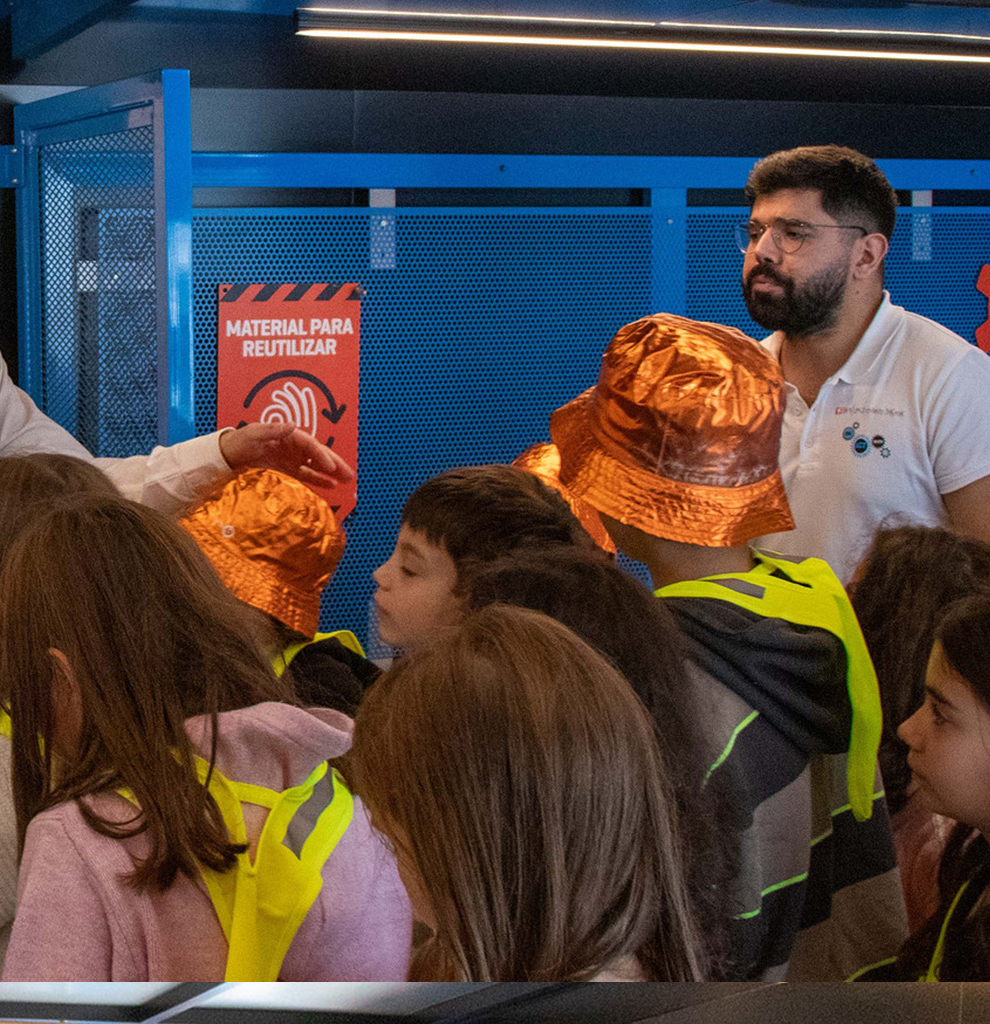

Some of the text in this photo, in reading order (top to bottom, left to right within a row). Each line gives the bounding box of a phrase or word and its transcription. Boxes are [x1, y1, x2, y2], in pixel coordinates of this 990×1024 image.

[226, 317, 354, 337] MATERIAL PARA
[242, 338, 337, 358] REUTILIZAR
